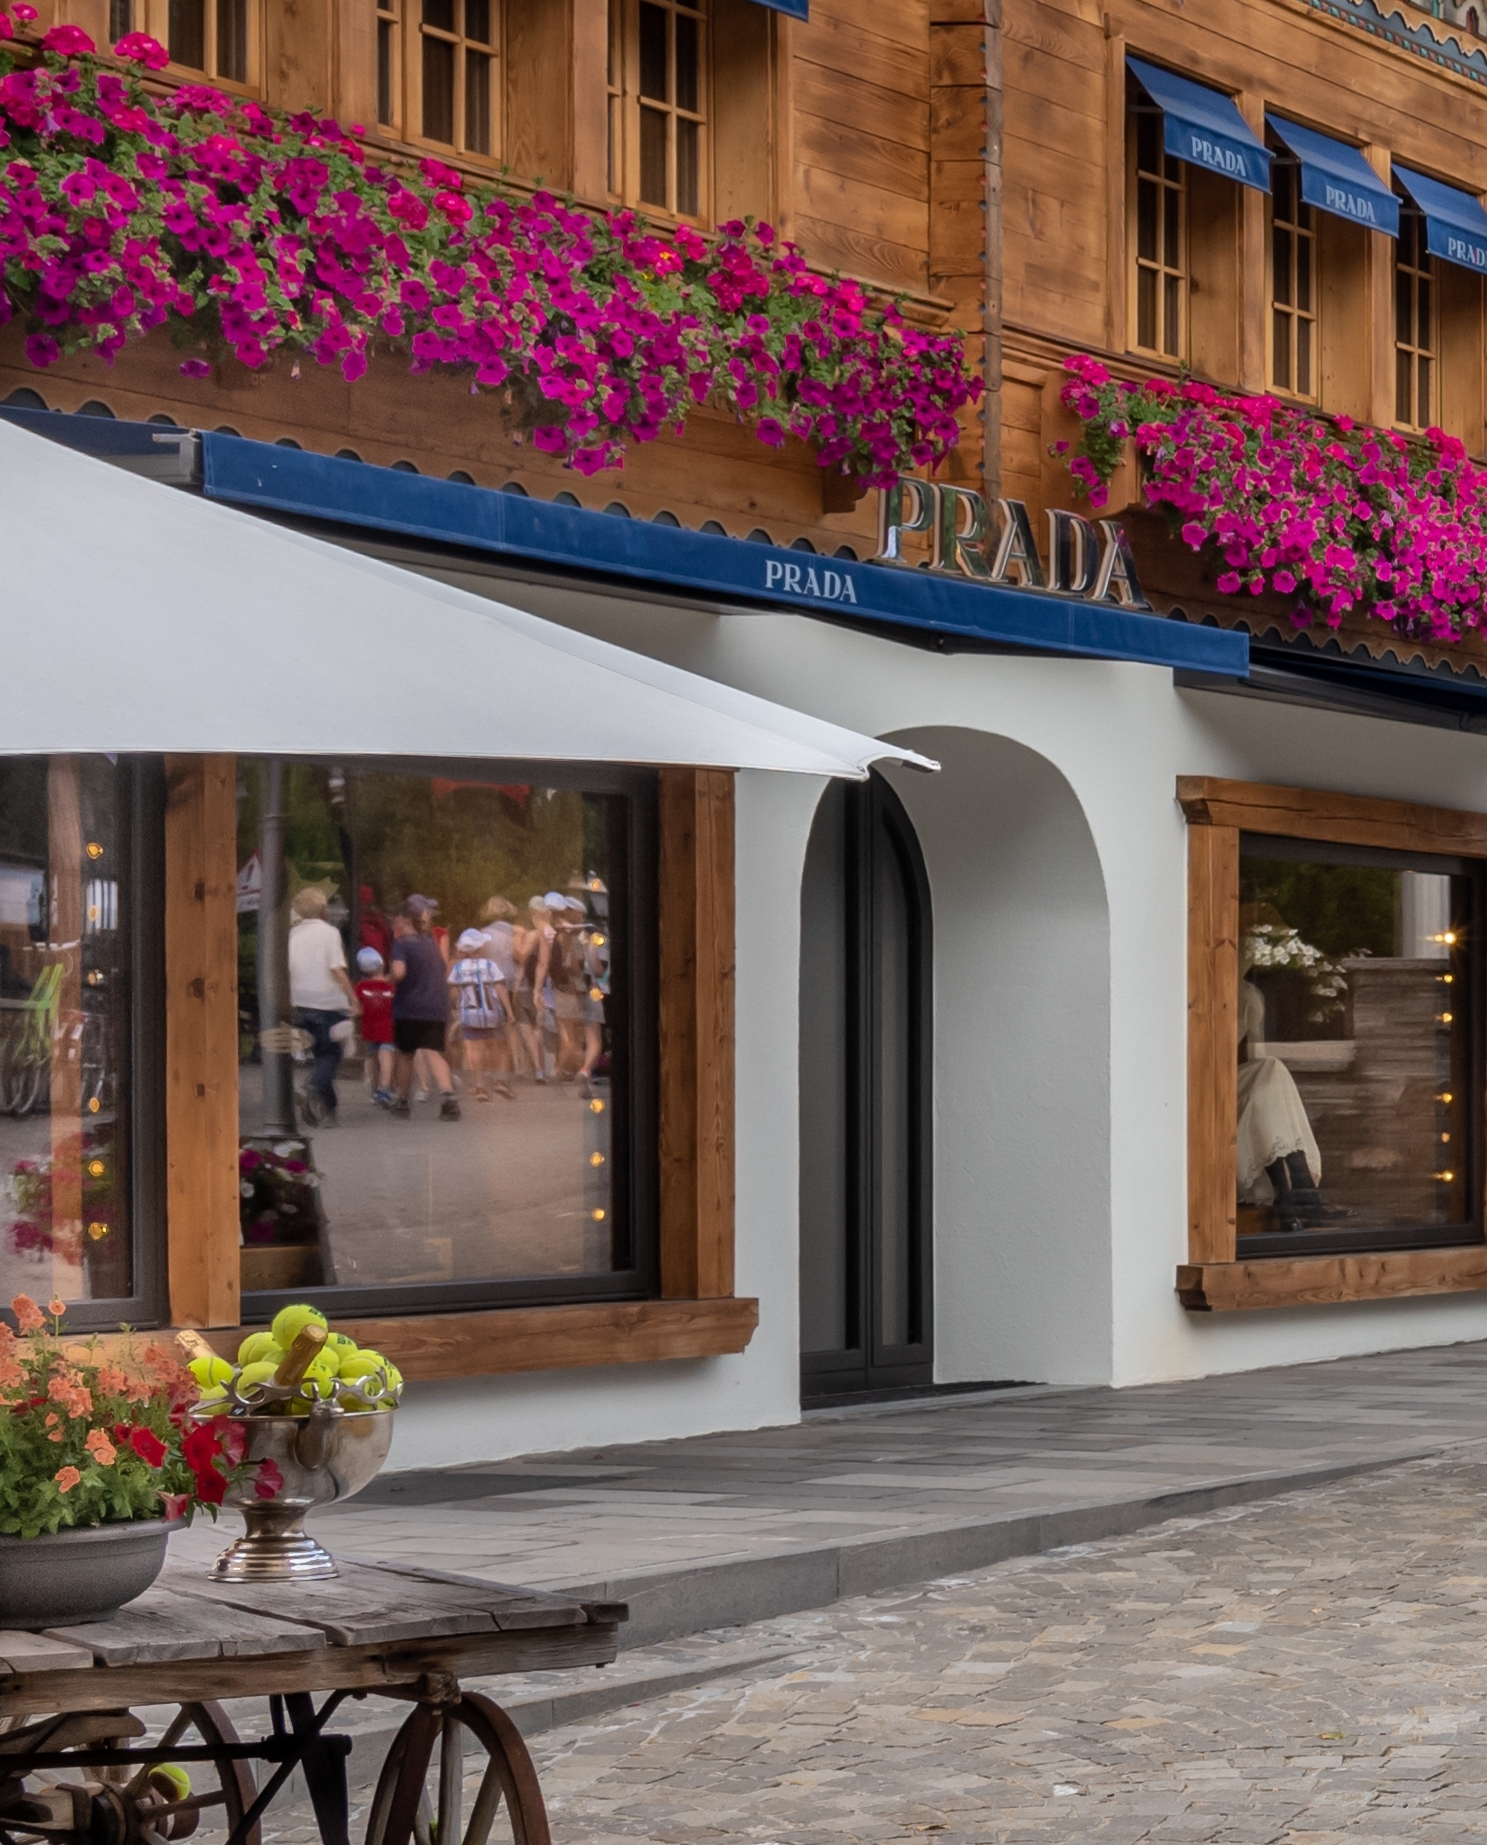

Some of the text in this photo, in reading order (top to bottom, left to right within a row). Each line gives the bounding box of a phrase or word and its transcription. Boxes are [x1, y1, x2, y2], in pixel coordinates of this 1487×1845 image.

[1191, 135, 1246, 177] PRADA
[1325, 185, 1376, 223] PRADA
[873, 479, 1152, 609] PRADA
[764, 560, 858, 605] PRADA
